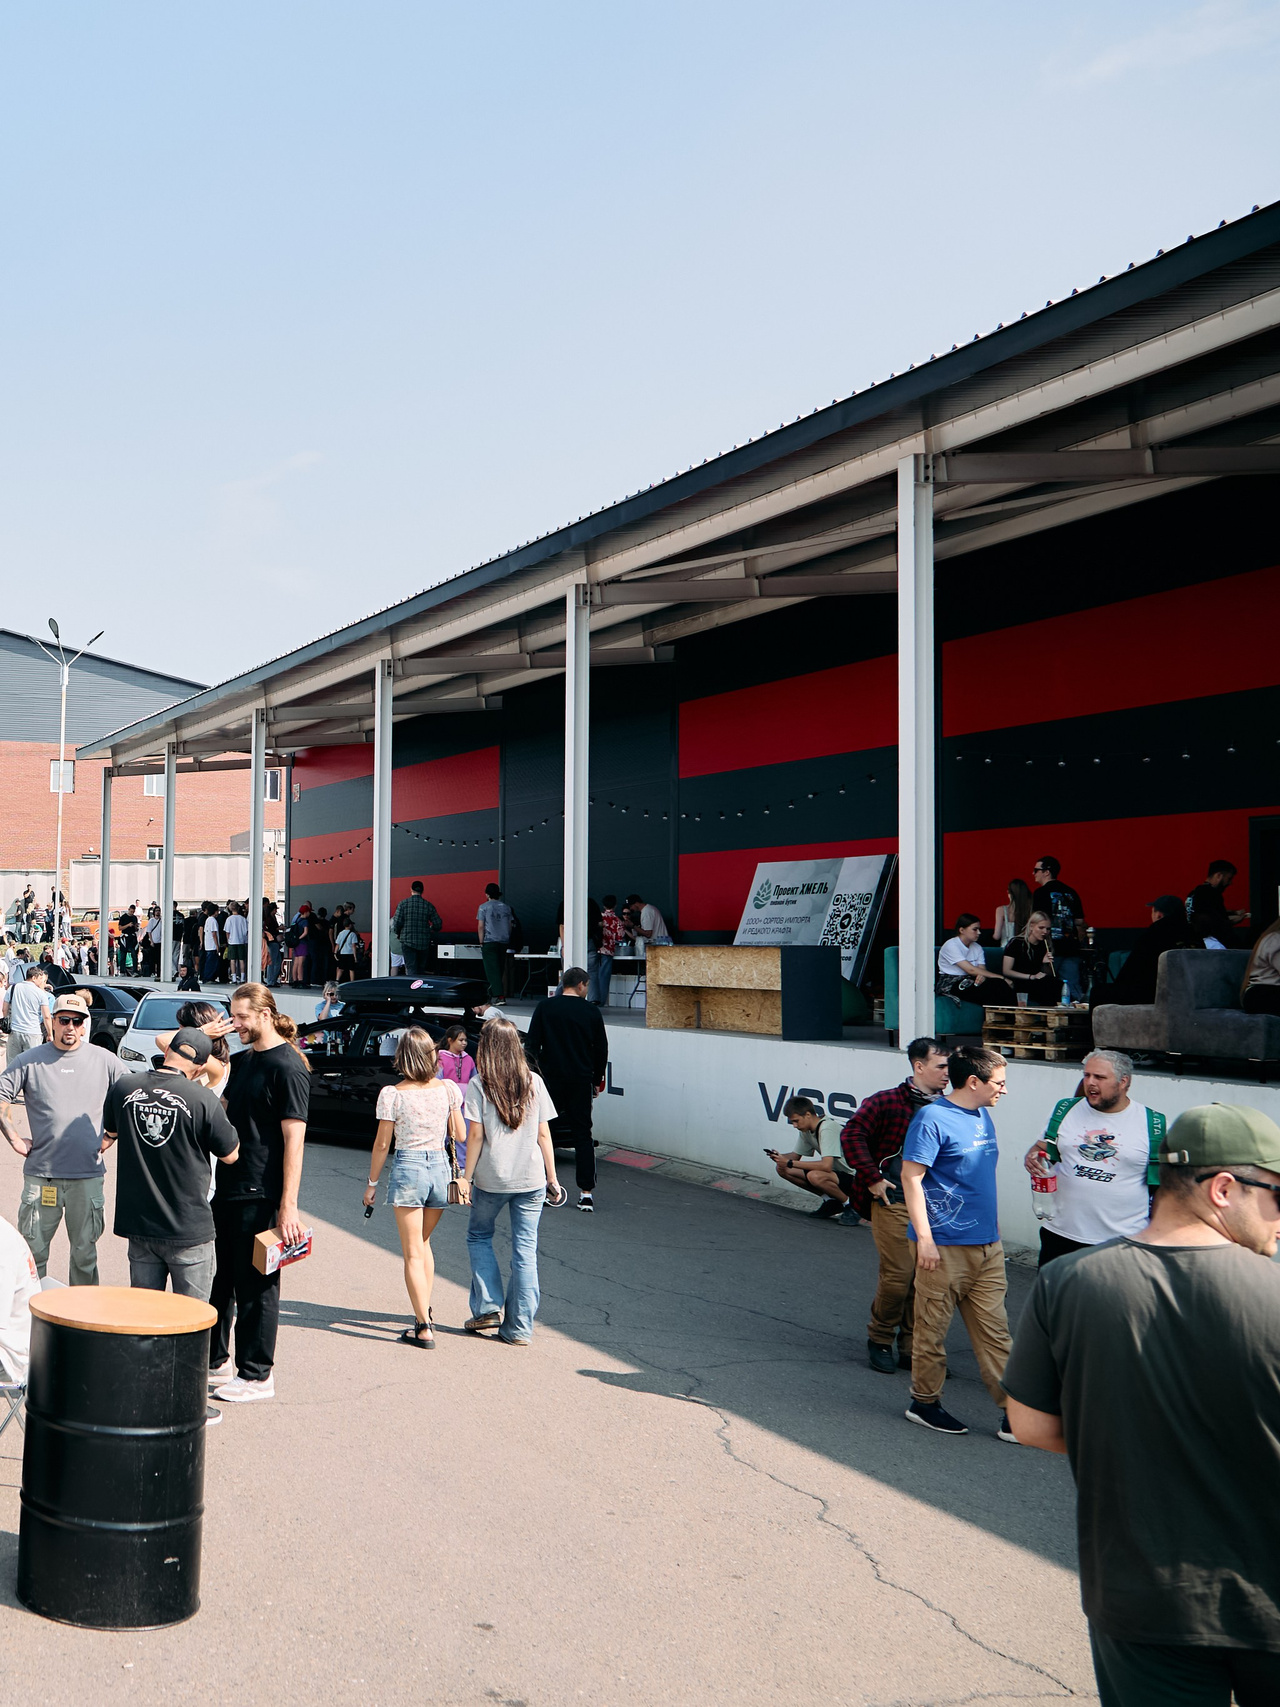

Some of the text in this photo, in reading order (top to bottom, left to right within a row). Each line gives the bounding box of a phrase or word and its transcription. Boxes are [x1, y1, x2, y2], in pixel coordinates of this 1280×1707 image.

[773, 882, 829, 899] Проект ХМЕЛЬ
[763, 916, 784, 925] СОРТОВ
[785, 916, 811, 924] ИМПОРТА
[747, 927, 771, 935] РЕДКОГО
[771, 926, 792, 935] КРАФТА
[122, 1088, 192, 1119] Las Vegas
[139, 1105, 172, 1116] RAIDERS
[1073, 1164, 1104, 1175] NEED
[1075, 1170, 1113, 1183] SPEED
